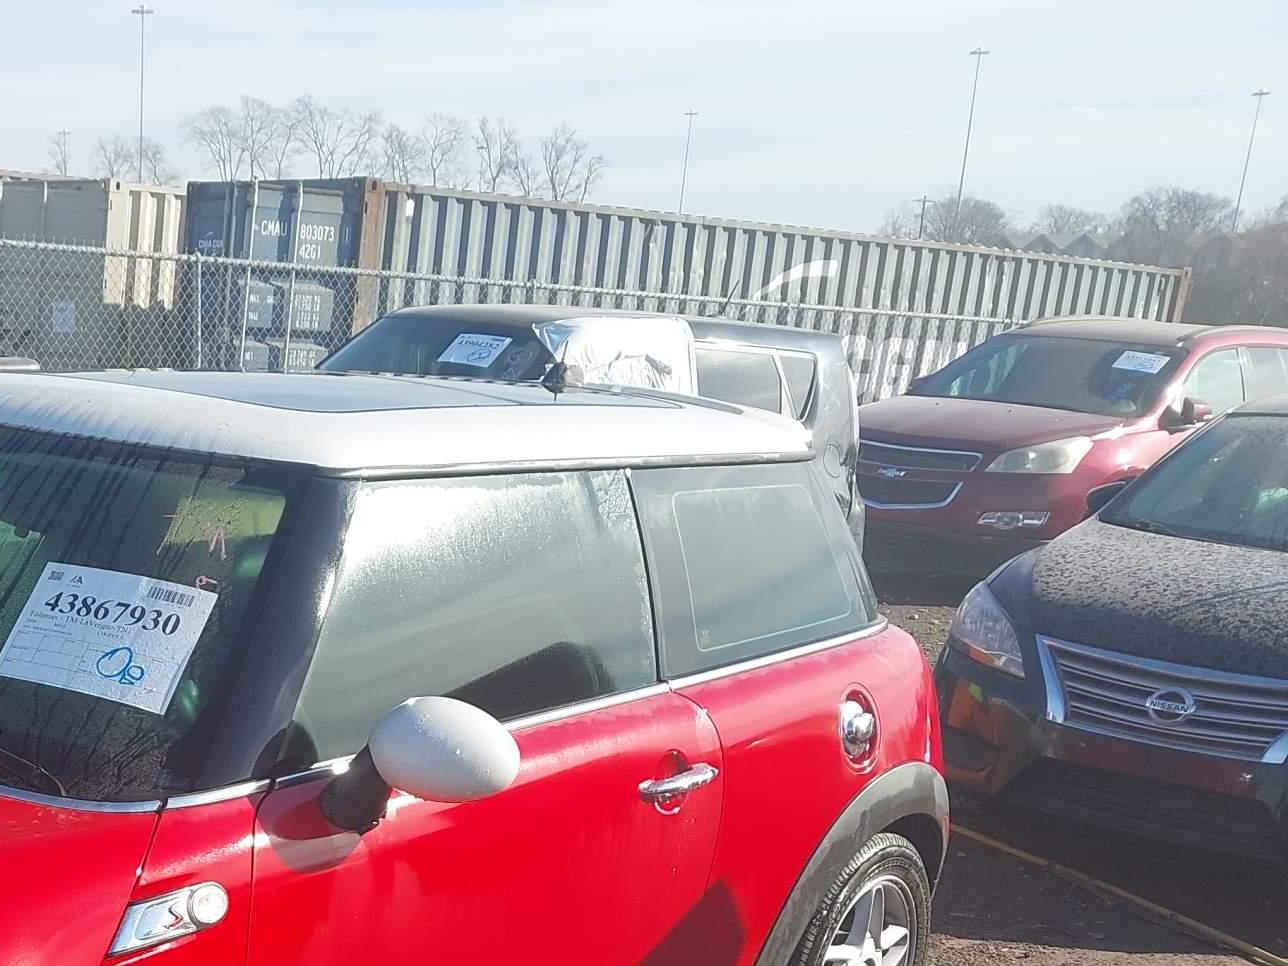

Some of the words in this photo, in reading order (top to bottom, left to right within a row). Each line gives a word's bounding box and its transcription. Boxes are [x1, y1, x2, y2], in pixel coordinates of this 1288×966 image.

[261, 219, 288, 236] CMAU
[300, 223, 335, 242] 803073
[298, 243, 321, 260] 42G1
[44, 591, 182, 637] 43867930
[1149, 700, 1191, 713] NISSAN
